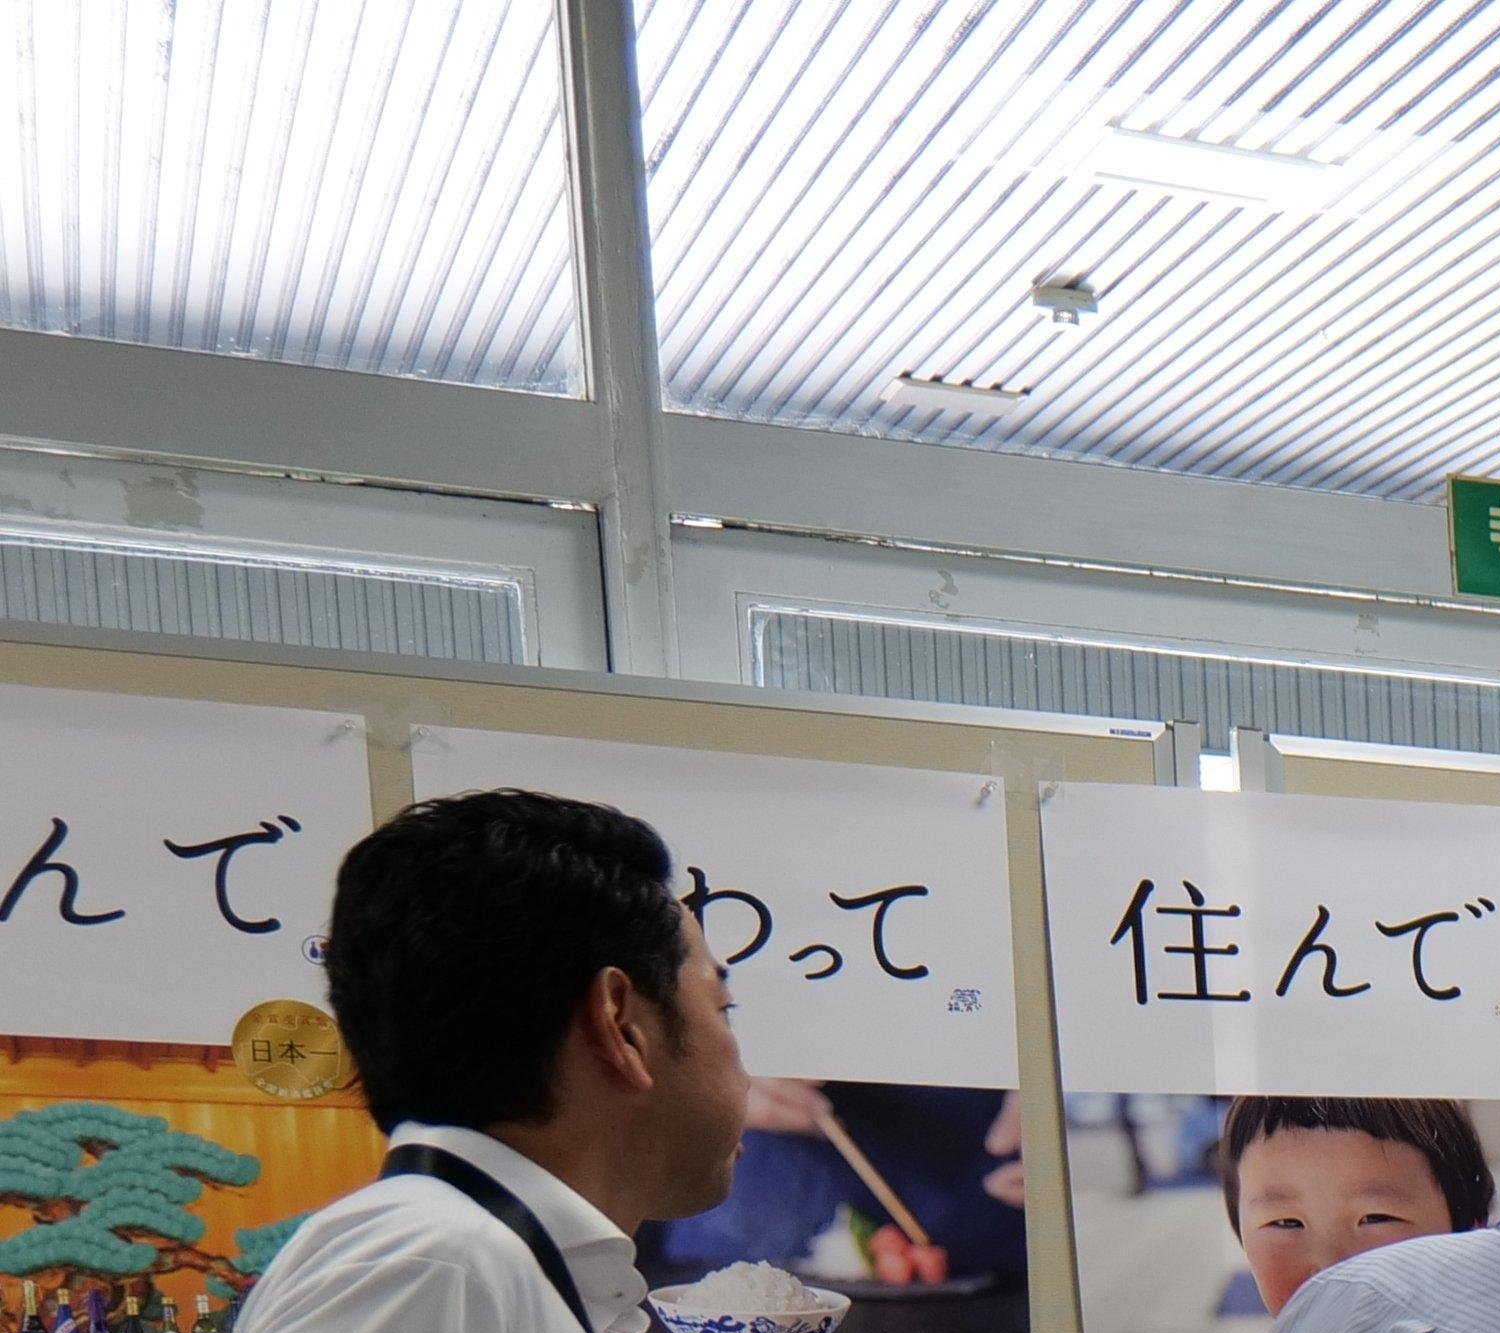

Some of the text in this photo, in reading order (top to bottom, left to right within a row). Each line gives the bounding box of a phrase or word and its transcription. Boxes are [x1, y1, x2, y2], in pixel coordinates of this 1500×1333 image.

[1110, 878, 1496, 1005] 住んで
[251, 1039, 337, 1064] 日本一
